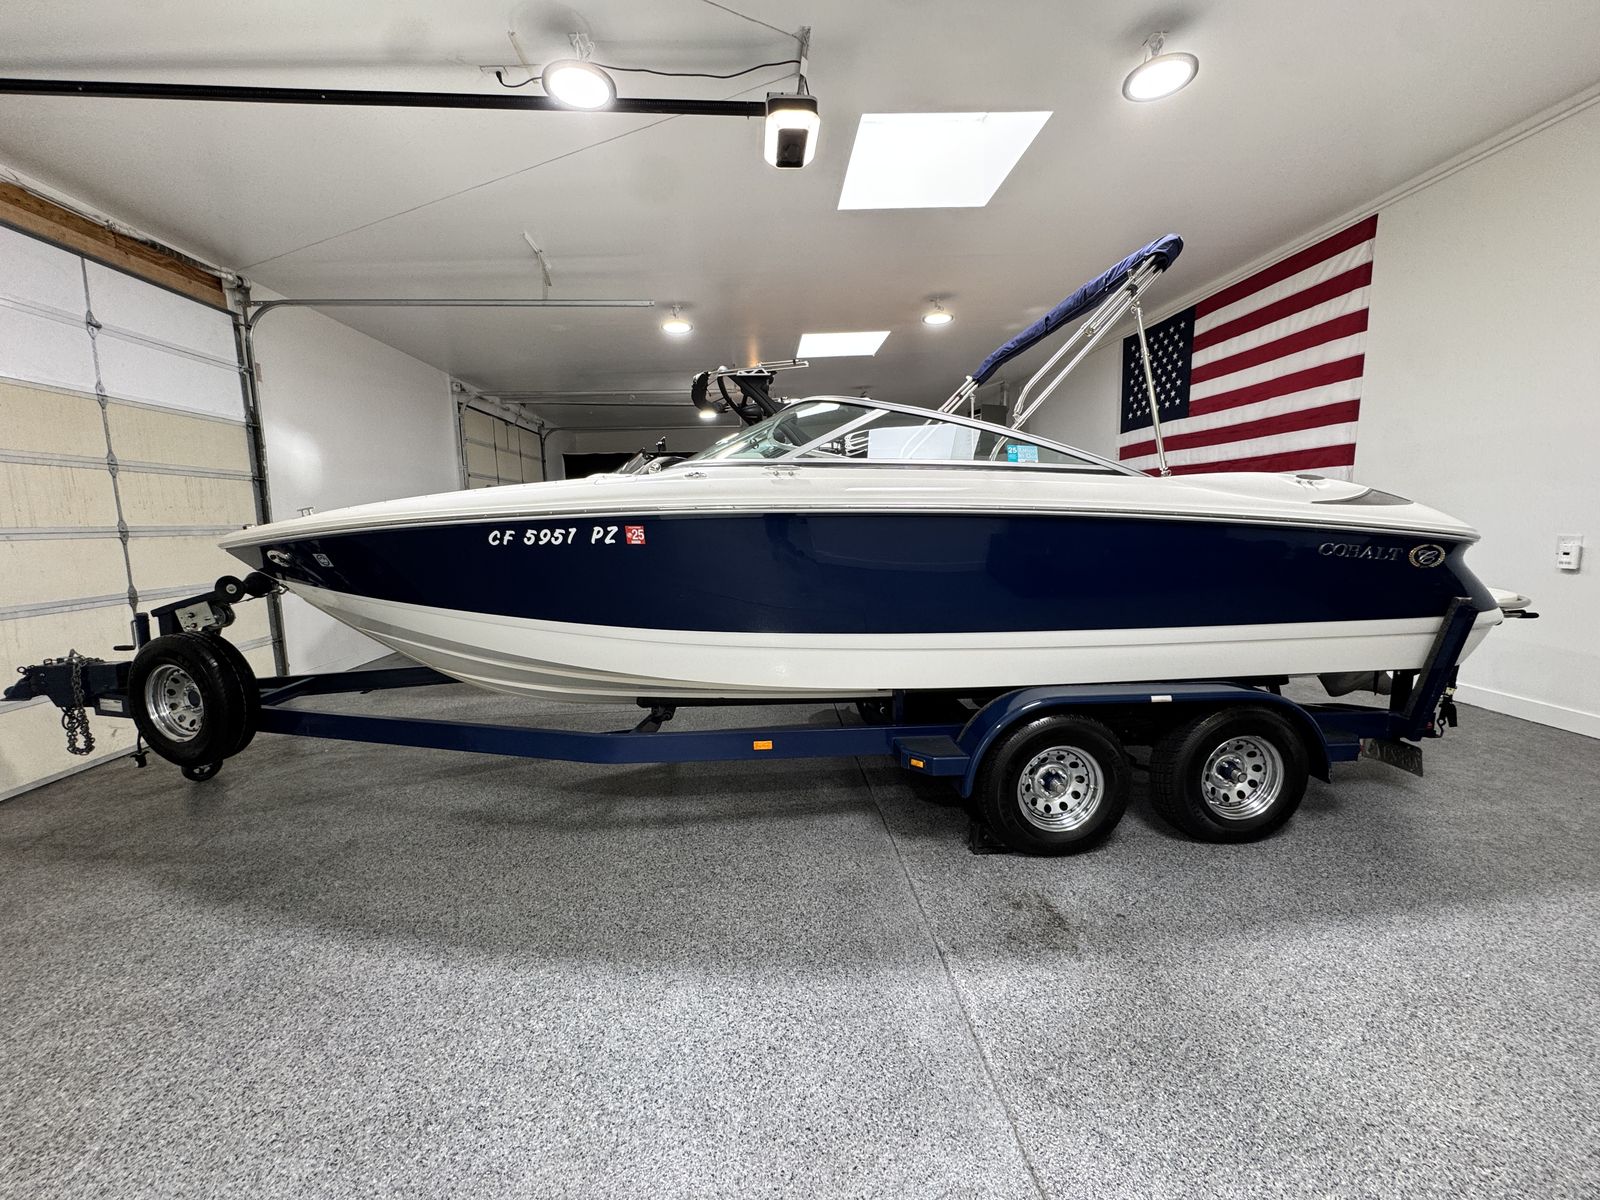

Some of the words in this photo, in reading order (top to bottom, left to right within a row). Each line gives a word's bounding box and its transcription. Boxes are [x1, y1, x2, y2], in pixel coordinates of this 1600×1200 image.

[488, 530, 516, 546] CF
[591, 525, 619, 545] PZ
[631, 528, 645, 541] 25
[1318, 542, 1403, 561] COBALT
